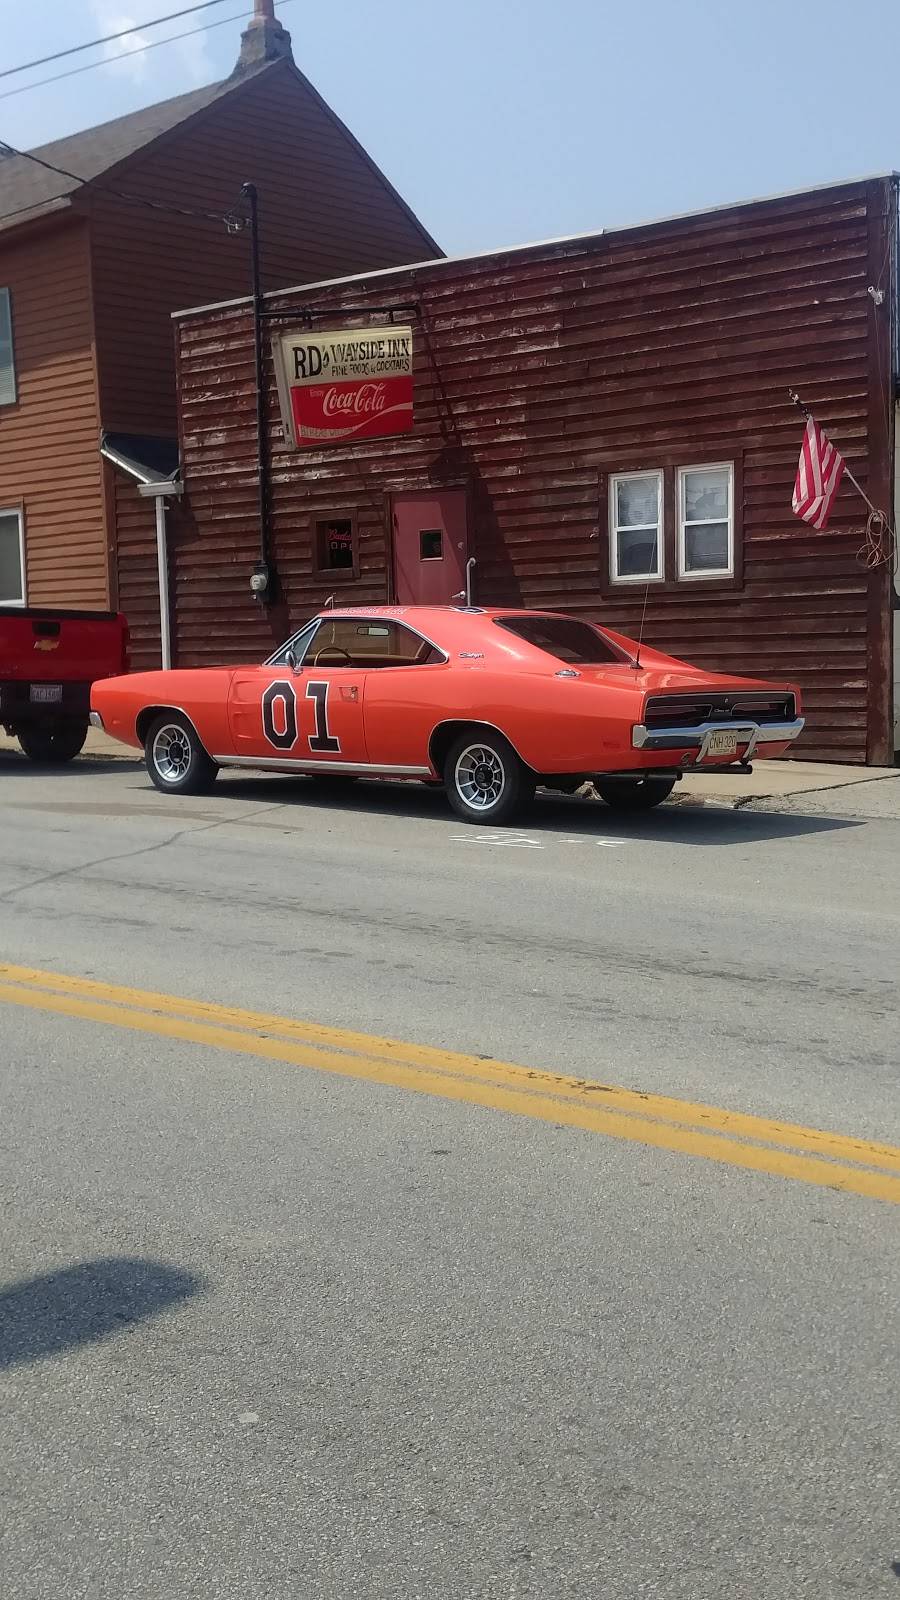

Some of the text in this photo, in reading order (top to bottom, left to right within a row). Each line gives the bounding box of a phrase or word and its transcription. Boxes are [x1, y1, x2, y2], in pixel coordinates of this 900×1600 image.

[330, 341, 385, 363] WAYSIDE
[387, 338, 410, 358] INN
[331, 365, 348, 377] FINE
[376, 358, 410, 372] COCKTAILS
[261, 680, 342, 753] 01
[709, 735, 737, 749] CNH 320
